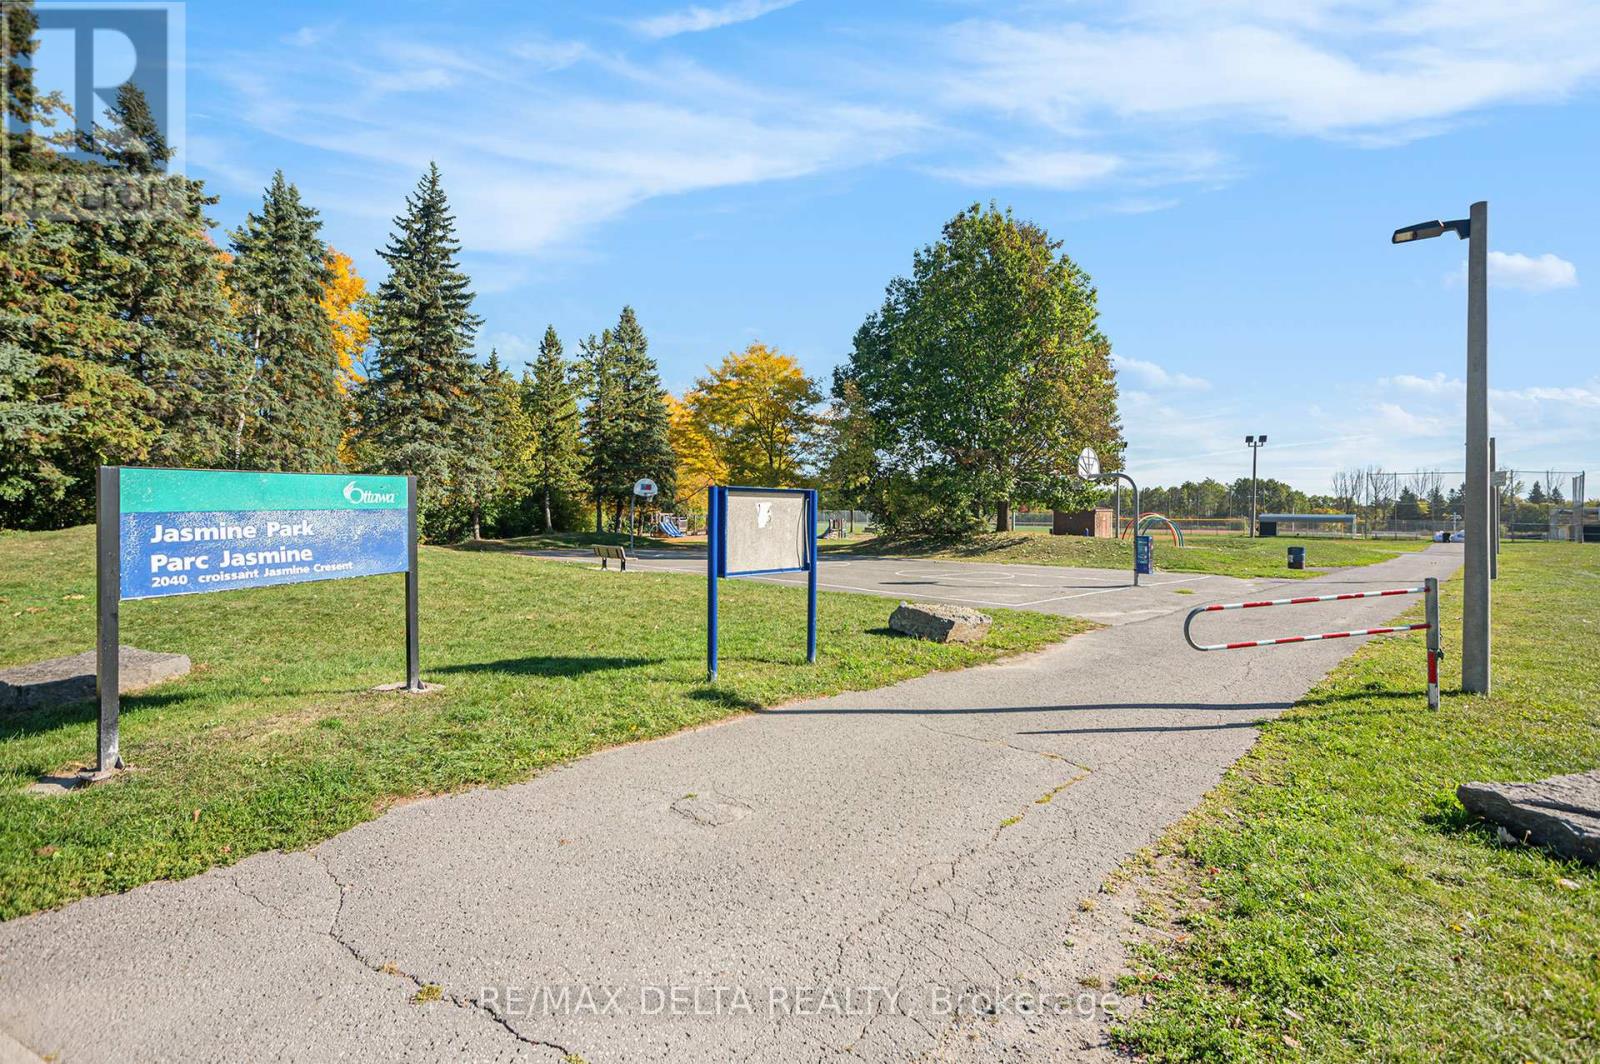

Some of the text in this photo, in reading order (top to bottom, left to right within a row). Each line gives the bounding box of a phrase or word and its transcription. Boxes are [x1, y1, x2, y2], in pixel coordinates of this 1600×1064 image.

[343, 481, 395, 504] Ottawa
[151, 519, 315, 543] Jasmine Park
[151, 546, 313, 573] Parc Jasmine
[151, 575, 188, 588] 2040
[197, 569, 259, 583] croissant
[263, 565, 310, 577] Jasmine
